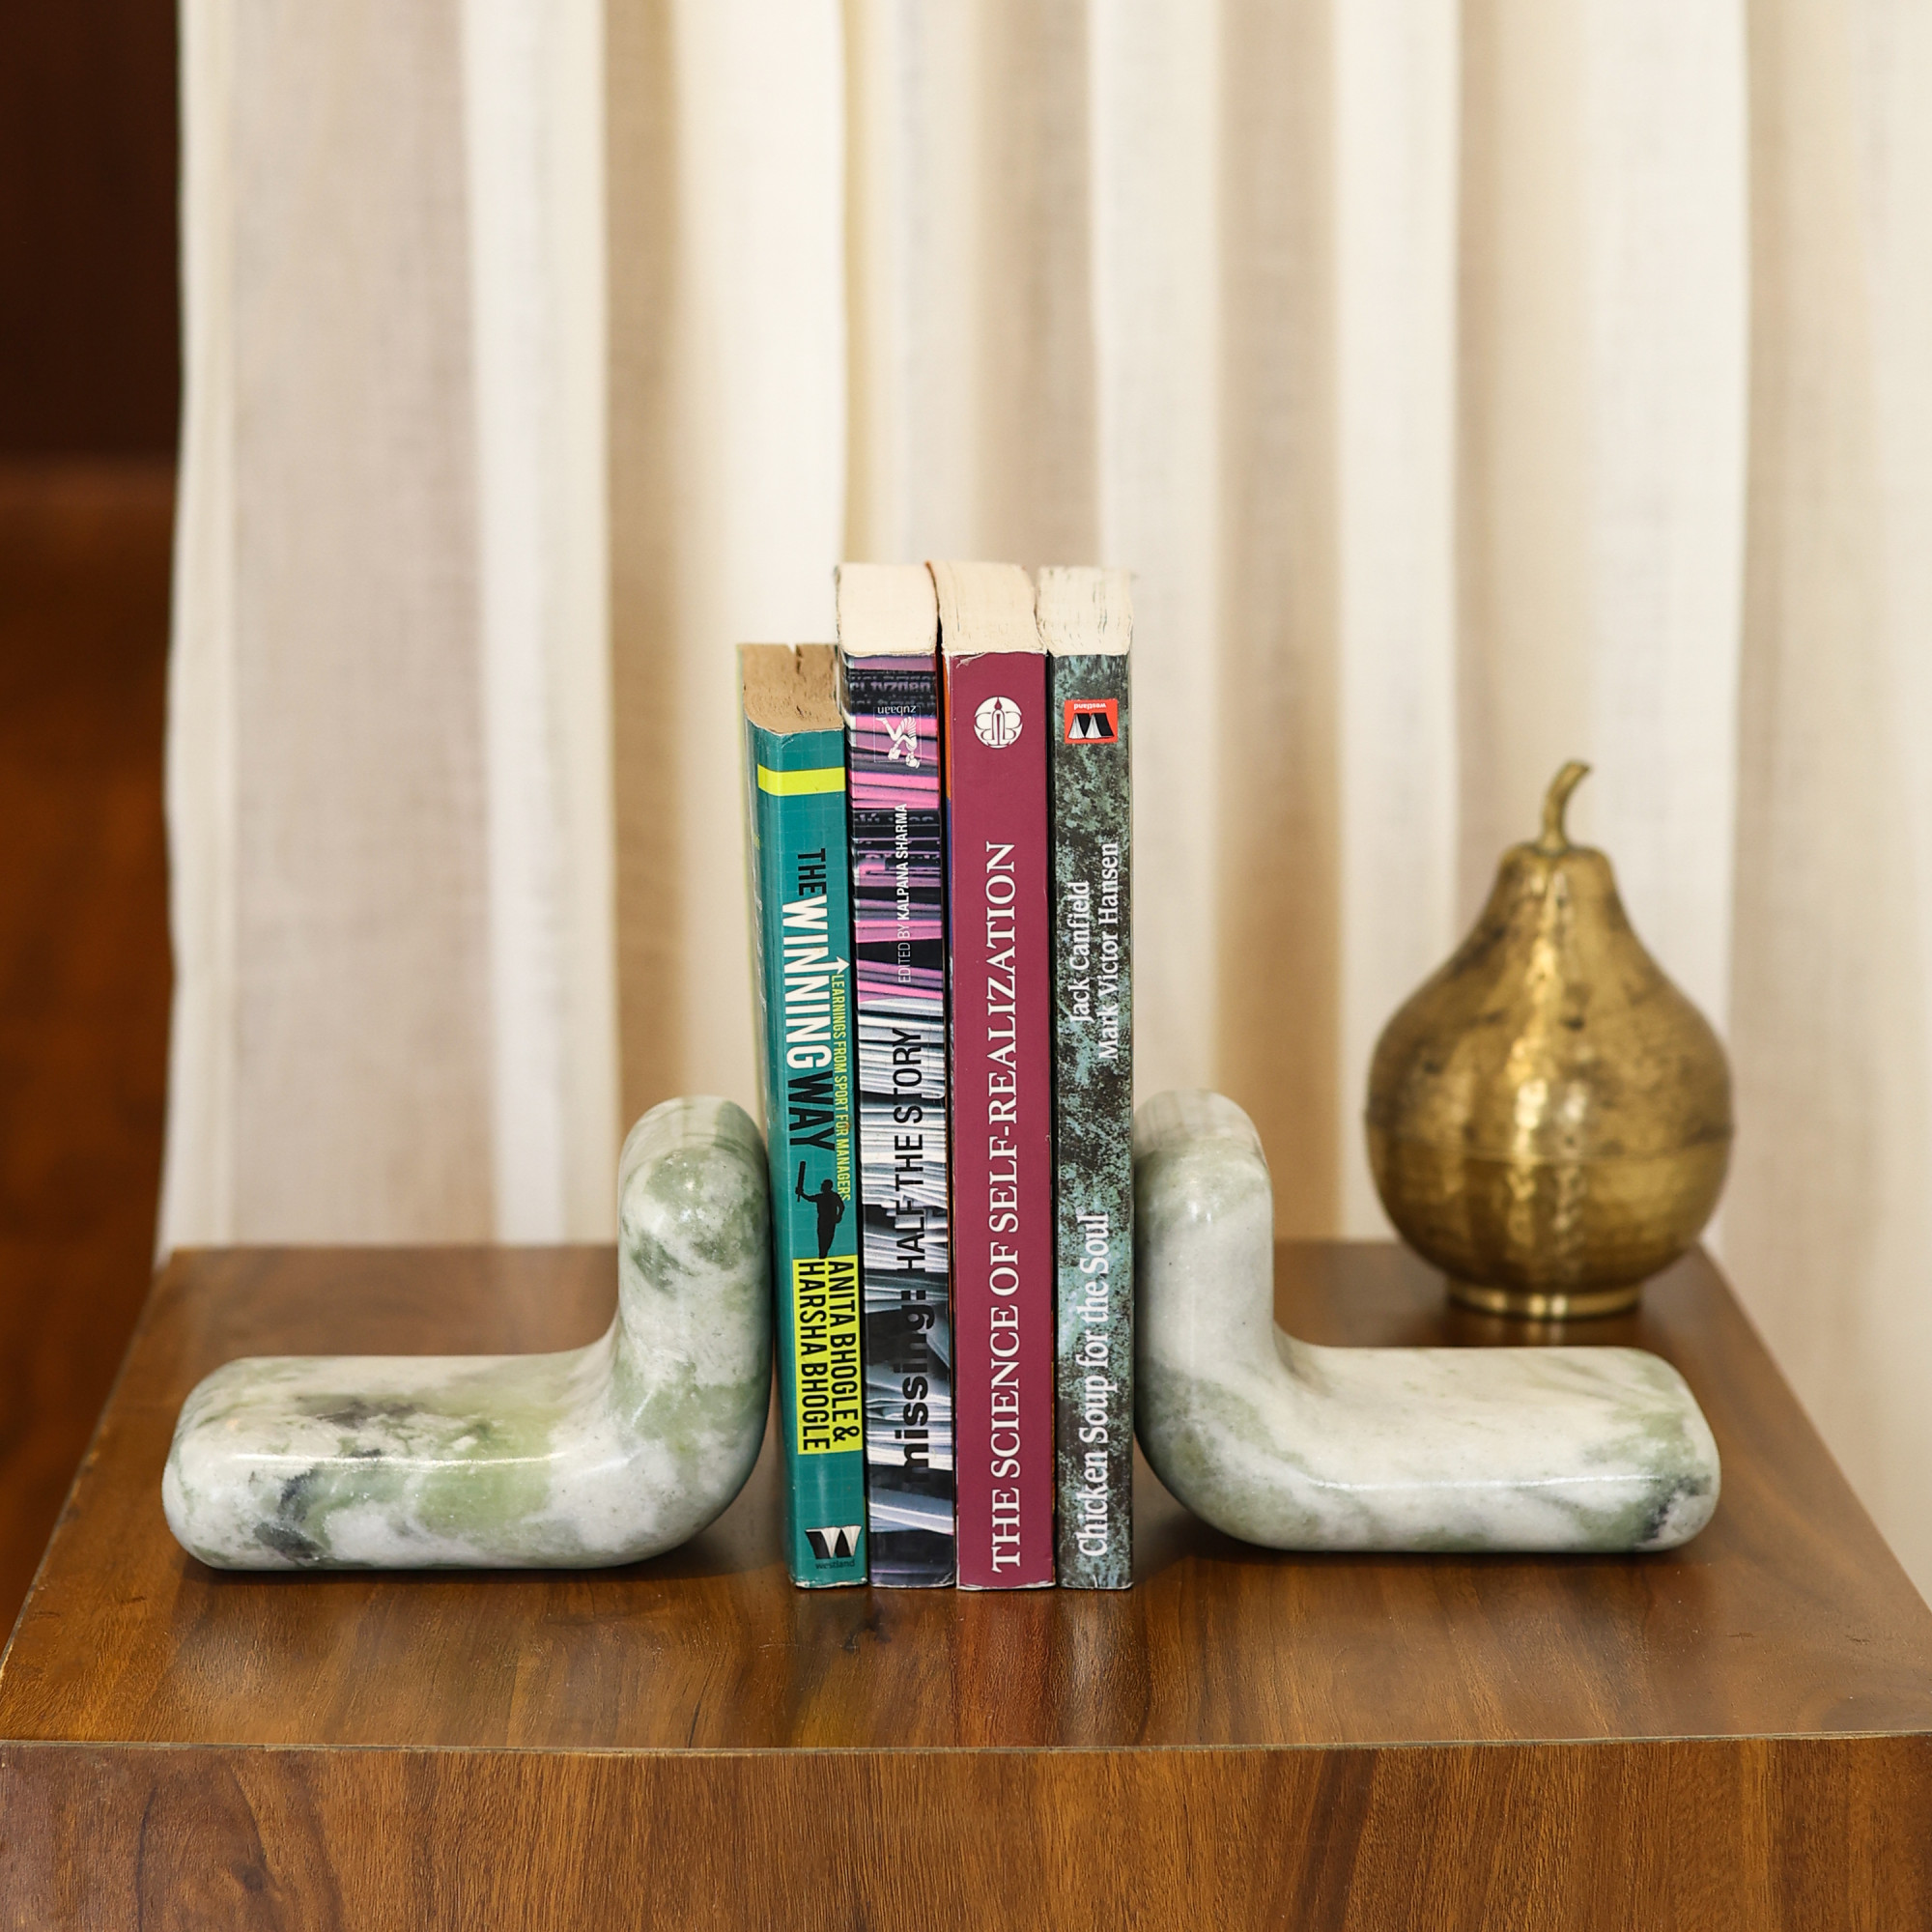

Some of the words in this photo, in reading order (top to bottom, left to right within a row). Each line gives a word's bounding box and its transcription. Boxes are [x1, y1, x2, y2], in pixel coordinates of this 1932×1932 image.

[877, 705, 917, 717] zubaan
[895, 804, 908, 859] SHARMA
[797, 847, 827, 896] THE
[896, 862, 910, 921] KALPANA
[1098, 842, 1119, 924] Hansen
[897, 924, 910, 939] BY
[1067, 880, 1090, 970] Canfield
[781, 895, 834, 1069] WINNING
[898, 942, 911, 983] EDITED
[1097, 930, 1119, 997] Victor
[832, 974, 846, 1038] LEARNINGS
[1067, 977, 1094, 1023] Jack
[1096, 1004, 1119, 1060] Mark
[833, 1039, 847, 1076] FROM
[986, 841, 1019, 1234] SELF-REALIZATION
[835, 1075, 849, 1112] SPORT
[893, 1028, 923, 1123] STORY
[786, 1069, 836, 1151] WAY
[836, 1114, 850, 1136] FOR
[837, 1138, 851, 1202] MANAGERS
[895, 1134, 923, 1191] THE
[895, 1201, 925, 1272] HALF
[1075, 1213, 1109, 1274] Soul
[828, 1261, 856, 1327] ANITA
[989, 1241, 1020, 1297] OF
[798, 1262, 828, 1356] HARSHA
[1076, 1280, 1109, 1323] the
[830, 1332, 859, 1422] BHOGLE
[1075, 1329, 1109, 1368] for
[801, 1362, 830, 1451] BHOGLE
[990, 1304, 1021, 1479] SCIENCE
[1079, 1375, 1118, 1444] Soup
[833, 1426, 860, 1442] &
[991, 1487, 1021, 1573] THE
[1076, 1451, 1108, 1556] Chicken
